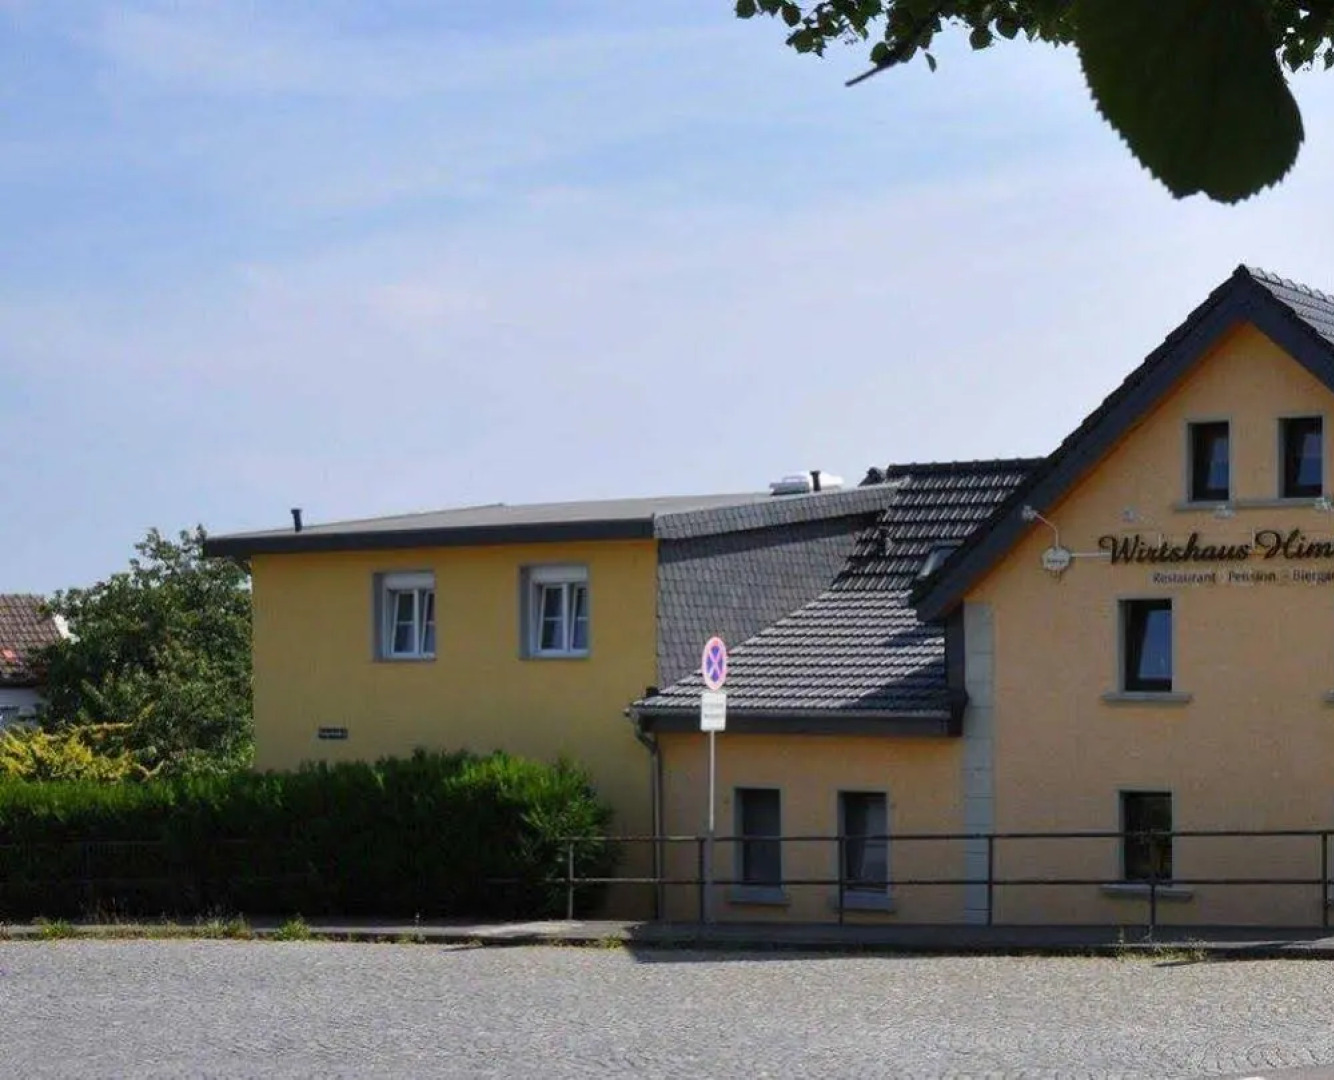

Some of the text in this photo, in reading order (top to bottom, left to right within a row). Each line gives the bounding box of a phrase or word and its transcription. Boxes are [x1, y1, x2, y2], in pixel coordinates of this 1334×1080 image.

[1098, 533, 1250, 565] Wirtshaus
[1153, 572, 1216, 585] Restaurant
[1228, 571, 1276, 583] Pension
